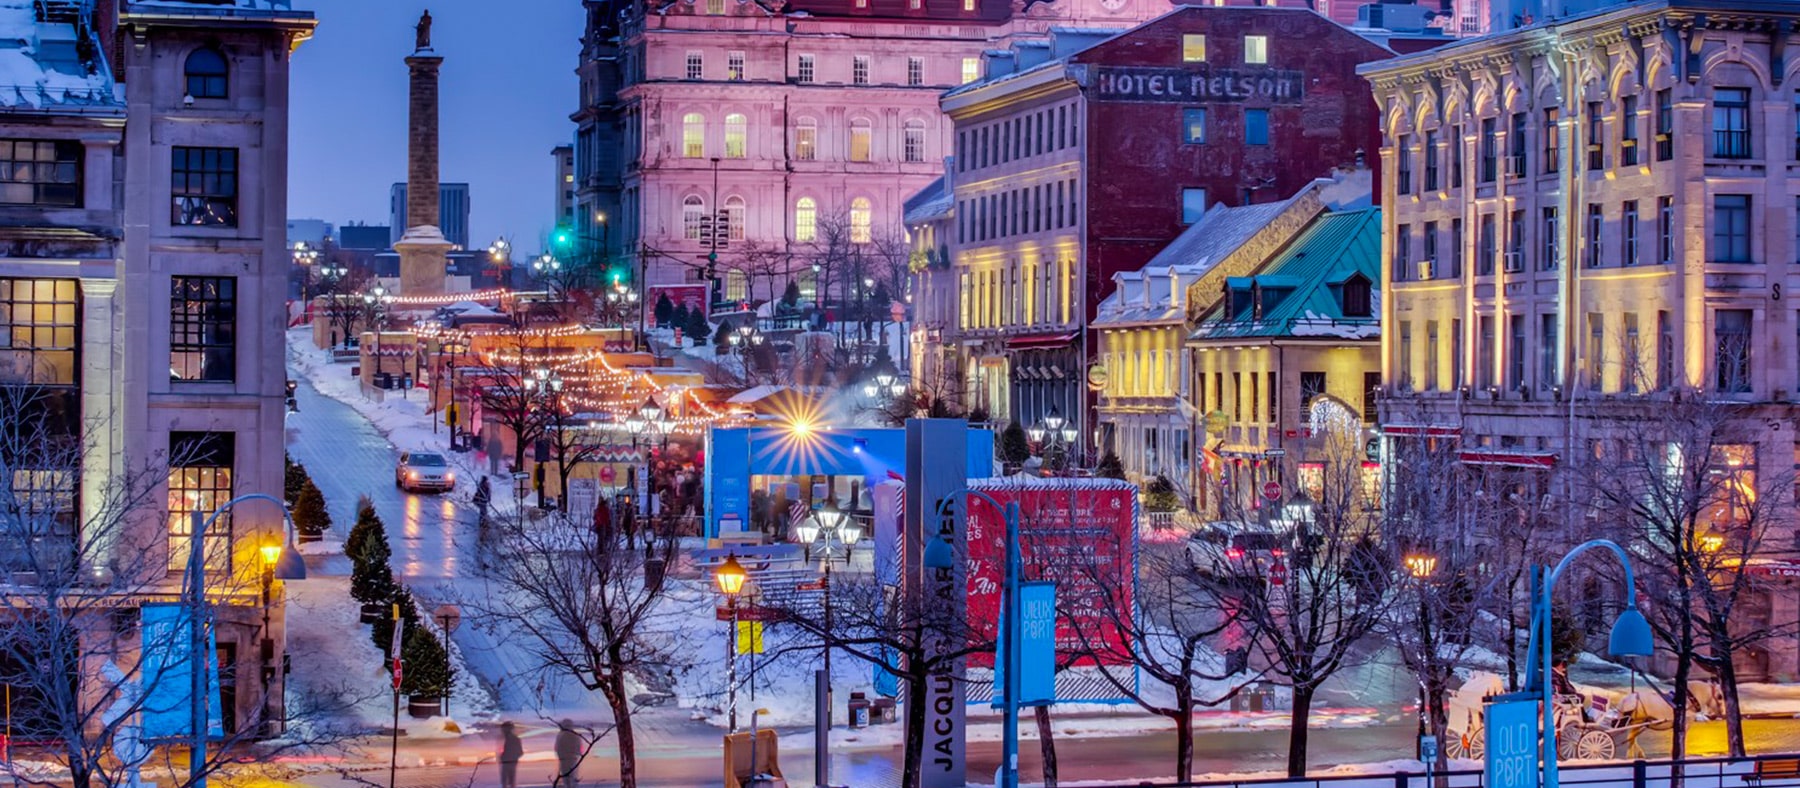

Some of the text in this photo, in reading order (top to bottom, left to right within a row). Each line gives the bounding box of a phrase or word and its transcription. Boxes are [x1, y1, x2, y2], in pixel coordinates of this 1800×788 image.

[1100, 74, 1182, 95] HOTEL
[1023, 600, 1051, 619] VIEUX
[1023, 619, 1051, 639] PORT
[1499, 723, 1529, 755] OLD
[1495, 754, 1534, 788] PORT
